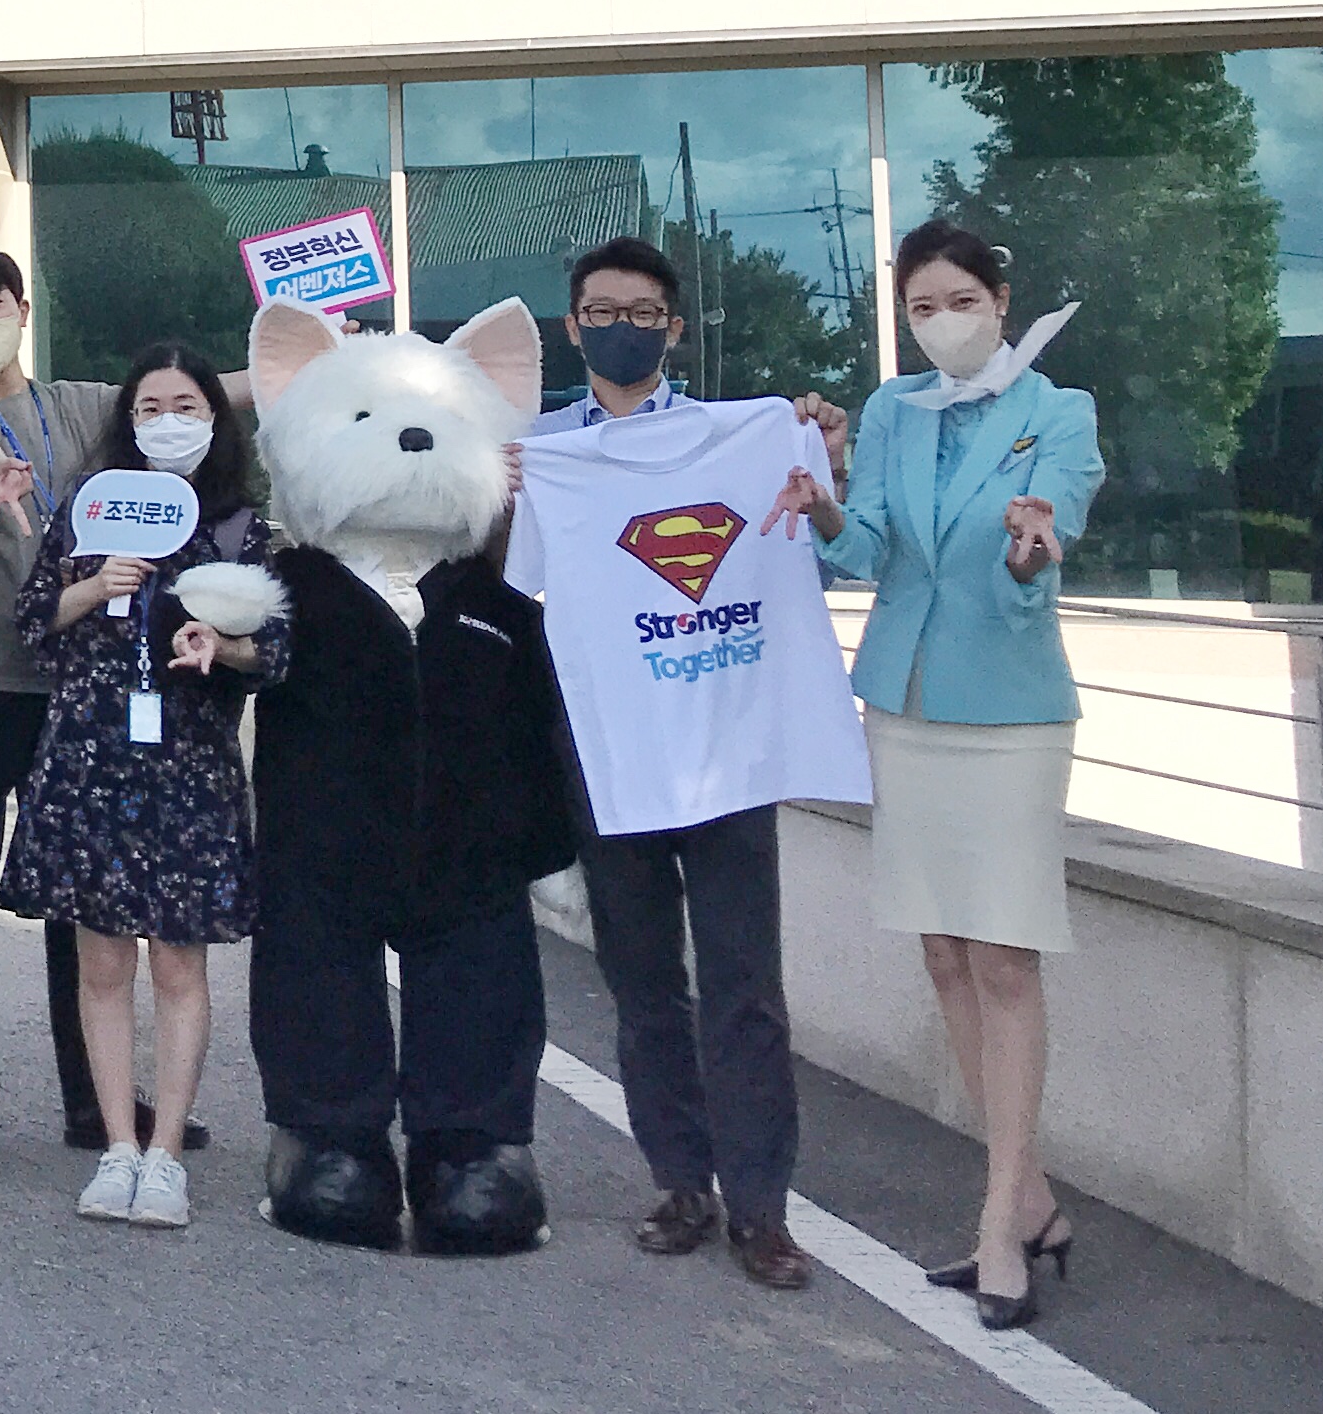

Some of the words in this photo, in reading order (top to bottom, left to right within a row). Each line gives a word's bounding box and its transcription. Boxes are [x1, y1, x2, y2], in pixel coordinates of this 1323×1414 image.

[259, 228, 364, 271] 정부혁신
[634, 600, 762, 643] Stronger
[642, 637, 764, 683] Together
